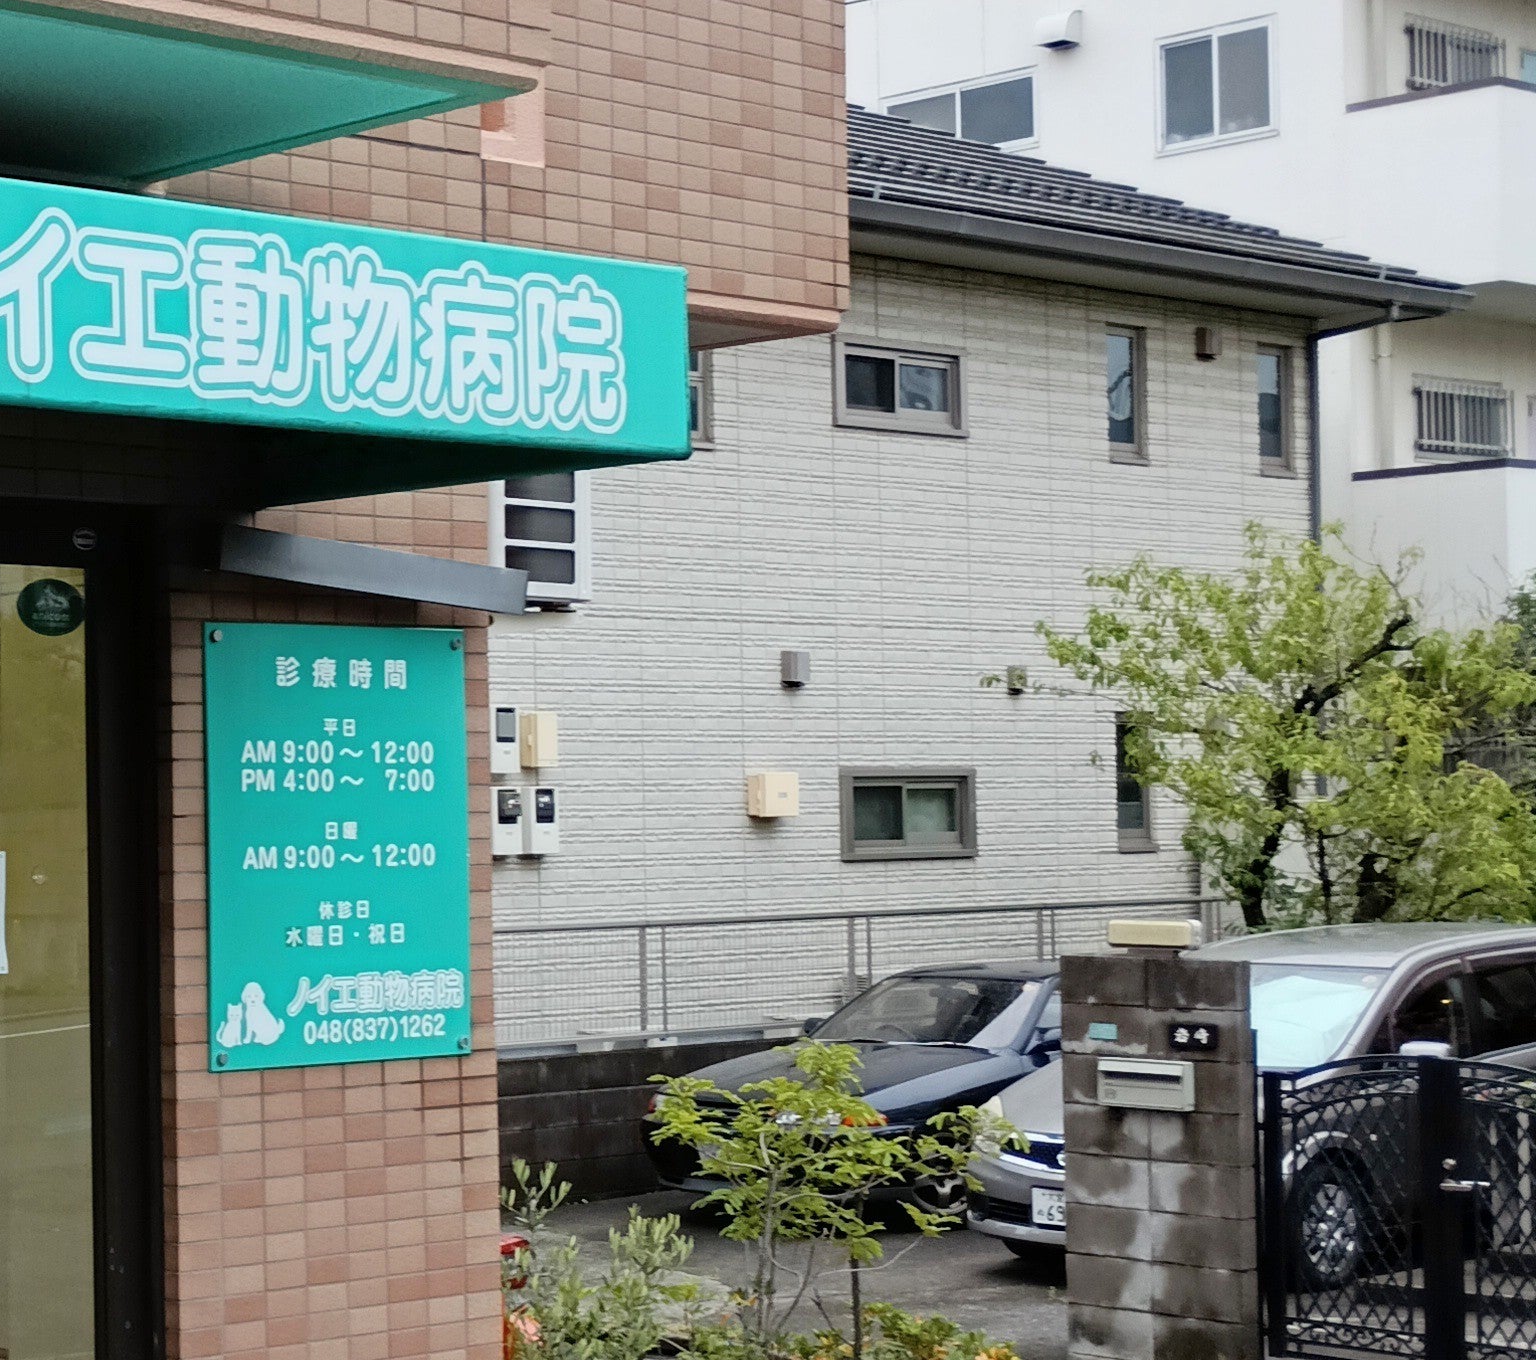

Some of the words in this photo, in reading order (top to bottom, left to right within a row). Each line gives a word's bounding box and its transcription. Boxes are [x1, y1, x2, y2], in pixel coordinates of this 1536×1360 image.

[275, 656, 407, 690] 診療時間
[323, 718, 357, 737] 平日
[325, 821, 358, 840] 日曜
[319, 900, 370, 920] 休診日
[286, 968, 464, 1017] ノイエ動物病院
